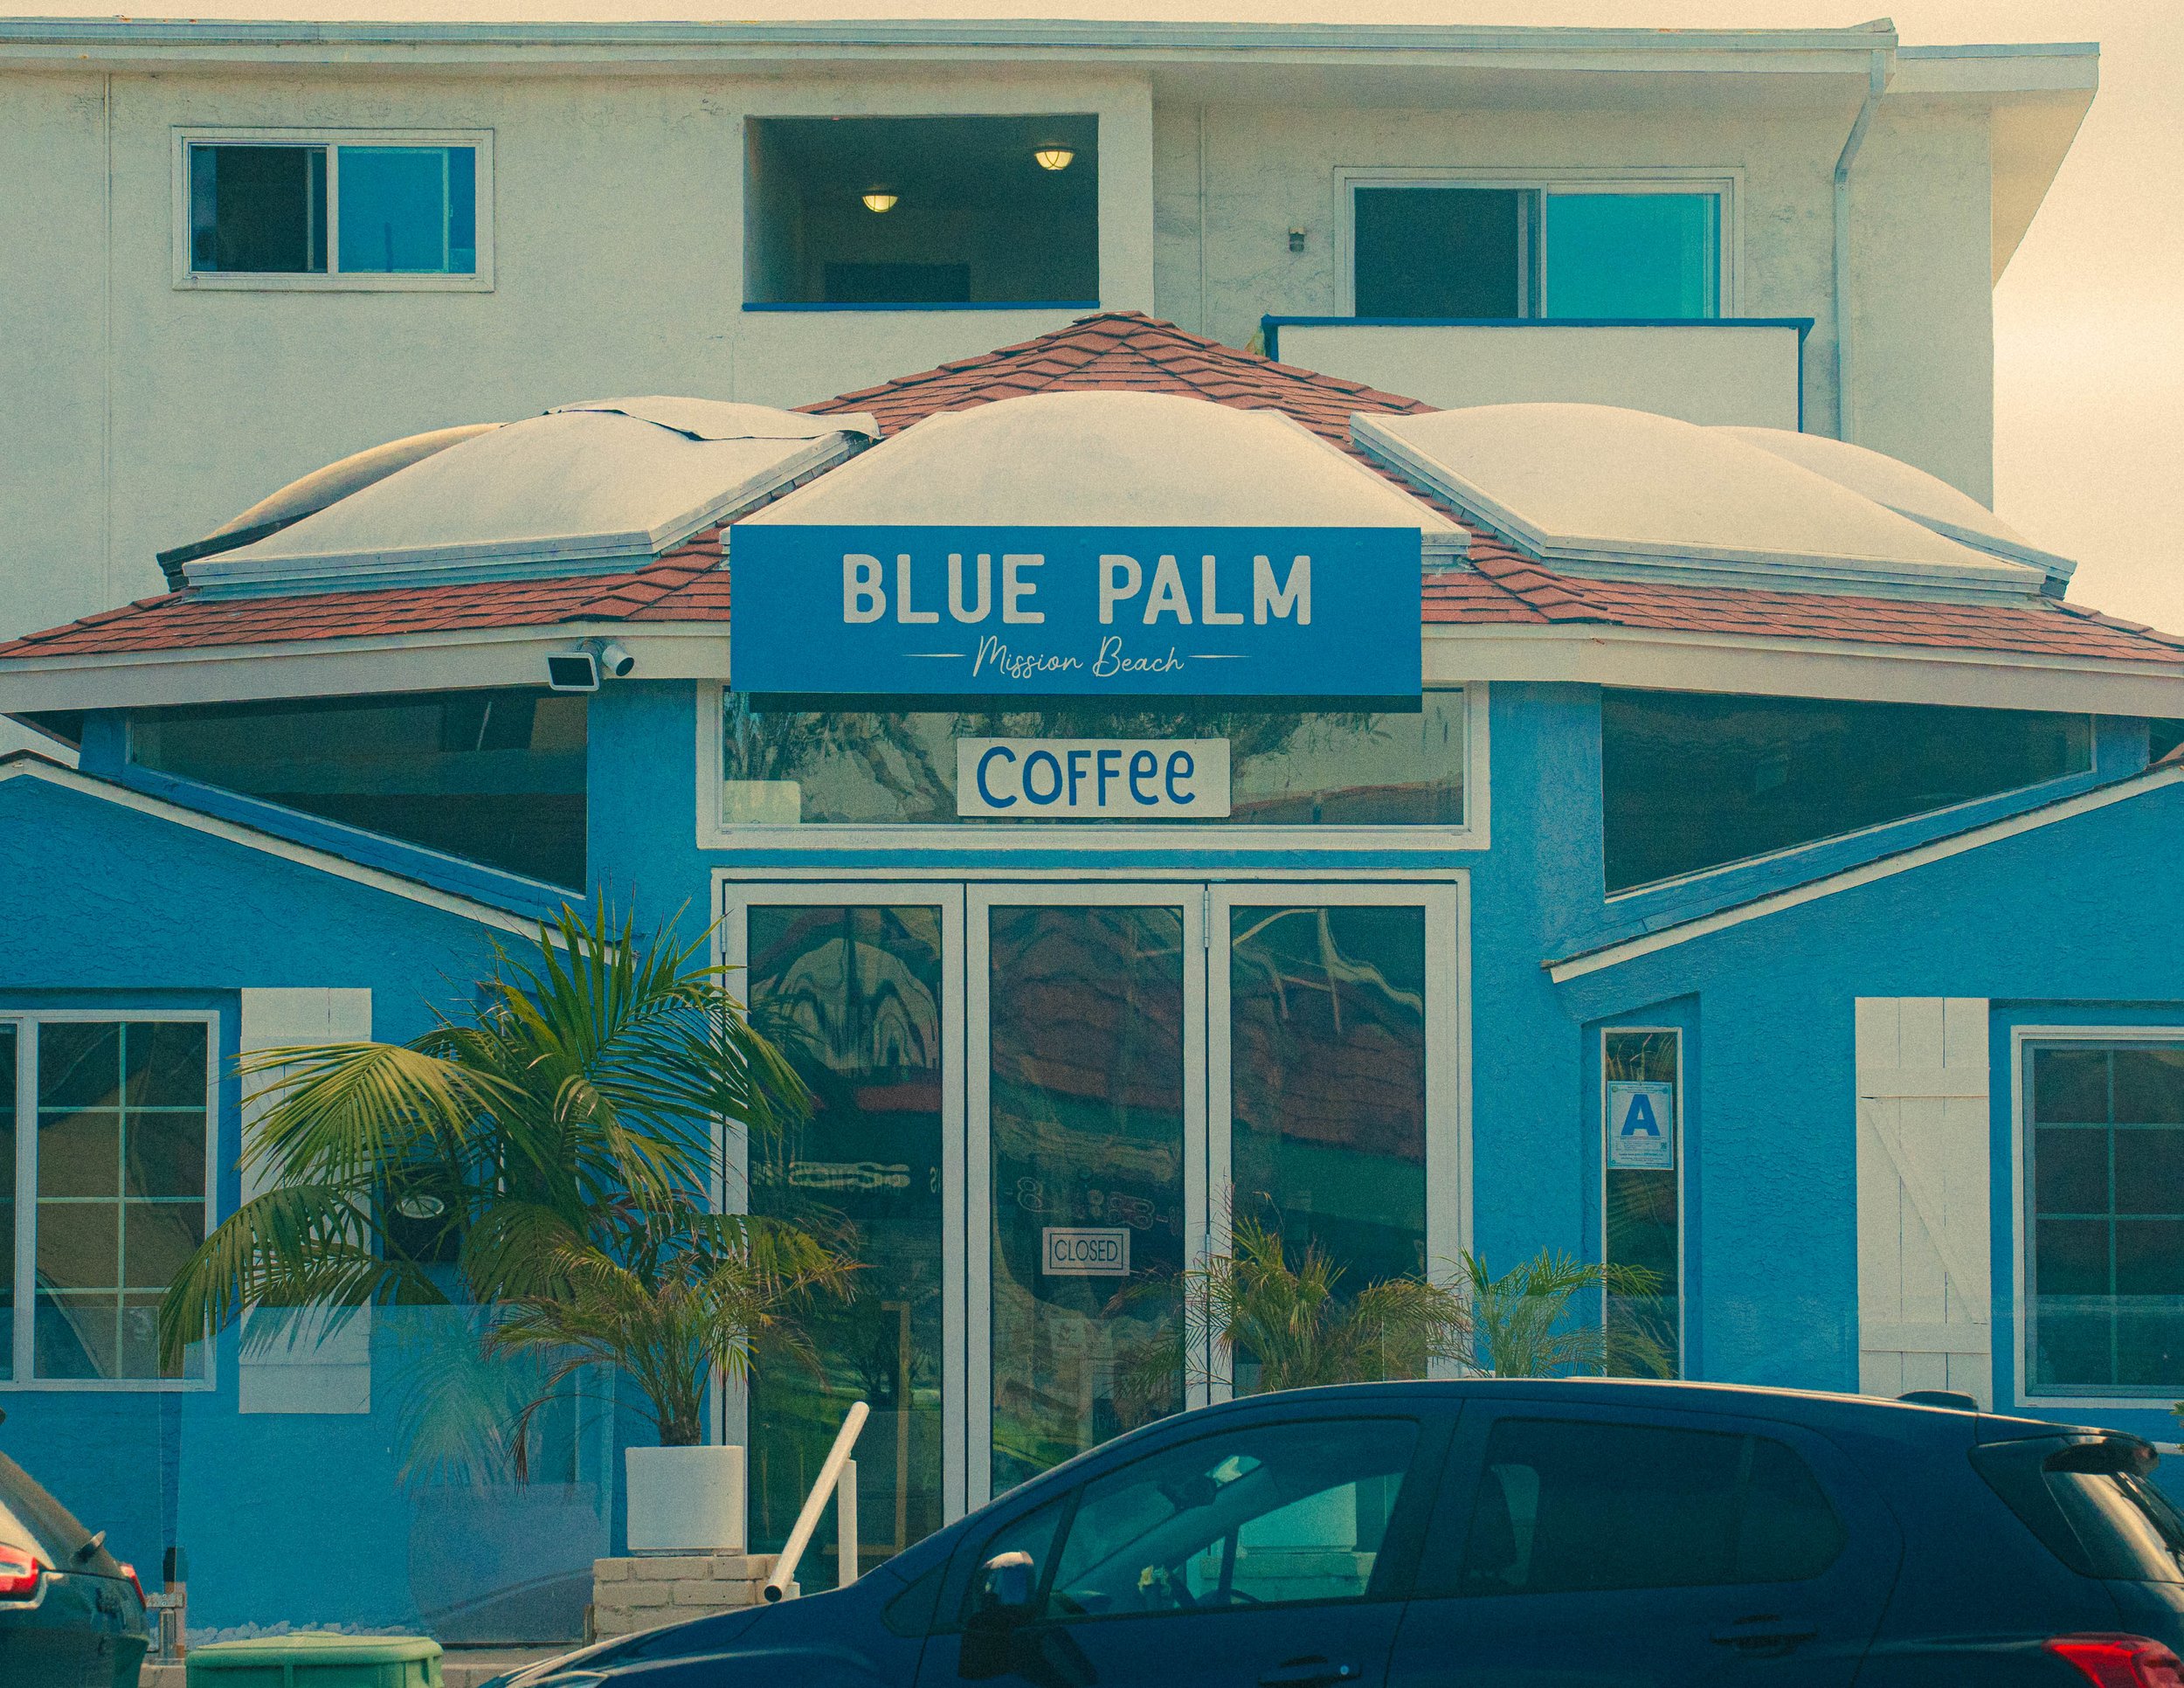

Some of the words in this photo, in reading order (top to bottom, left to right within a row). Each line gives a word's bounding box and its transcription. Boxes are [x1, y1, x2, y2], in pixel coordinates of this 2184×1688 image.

[843, 553, 1045, 624] BLUE
[1099, 555, 1311, 626] PALM
[972, 635, 1083, 679] Mission
[1092, 635, 1185, 678] Beach
[1621, 1093, 1661, 1137] A
[1054, 1239, 1118, 1262] CLOSED
